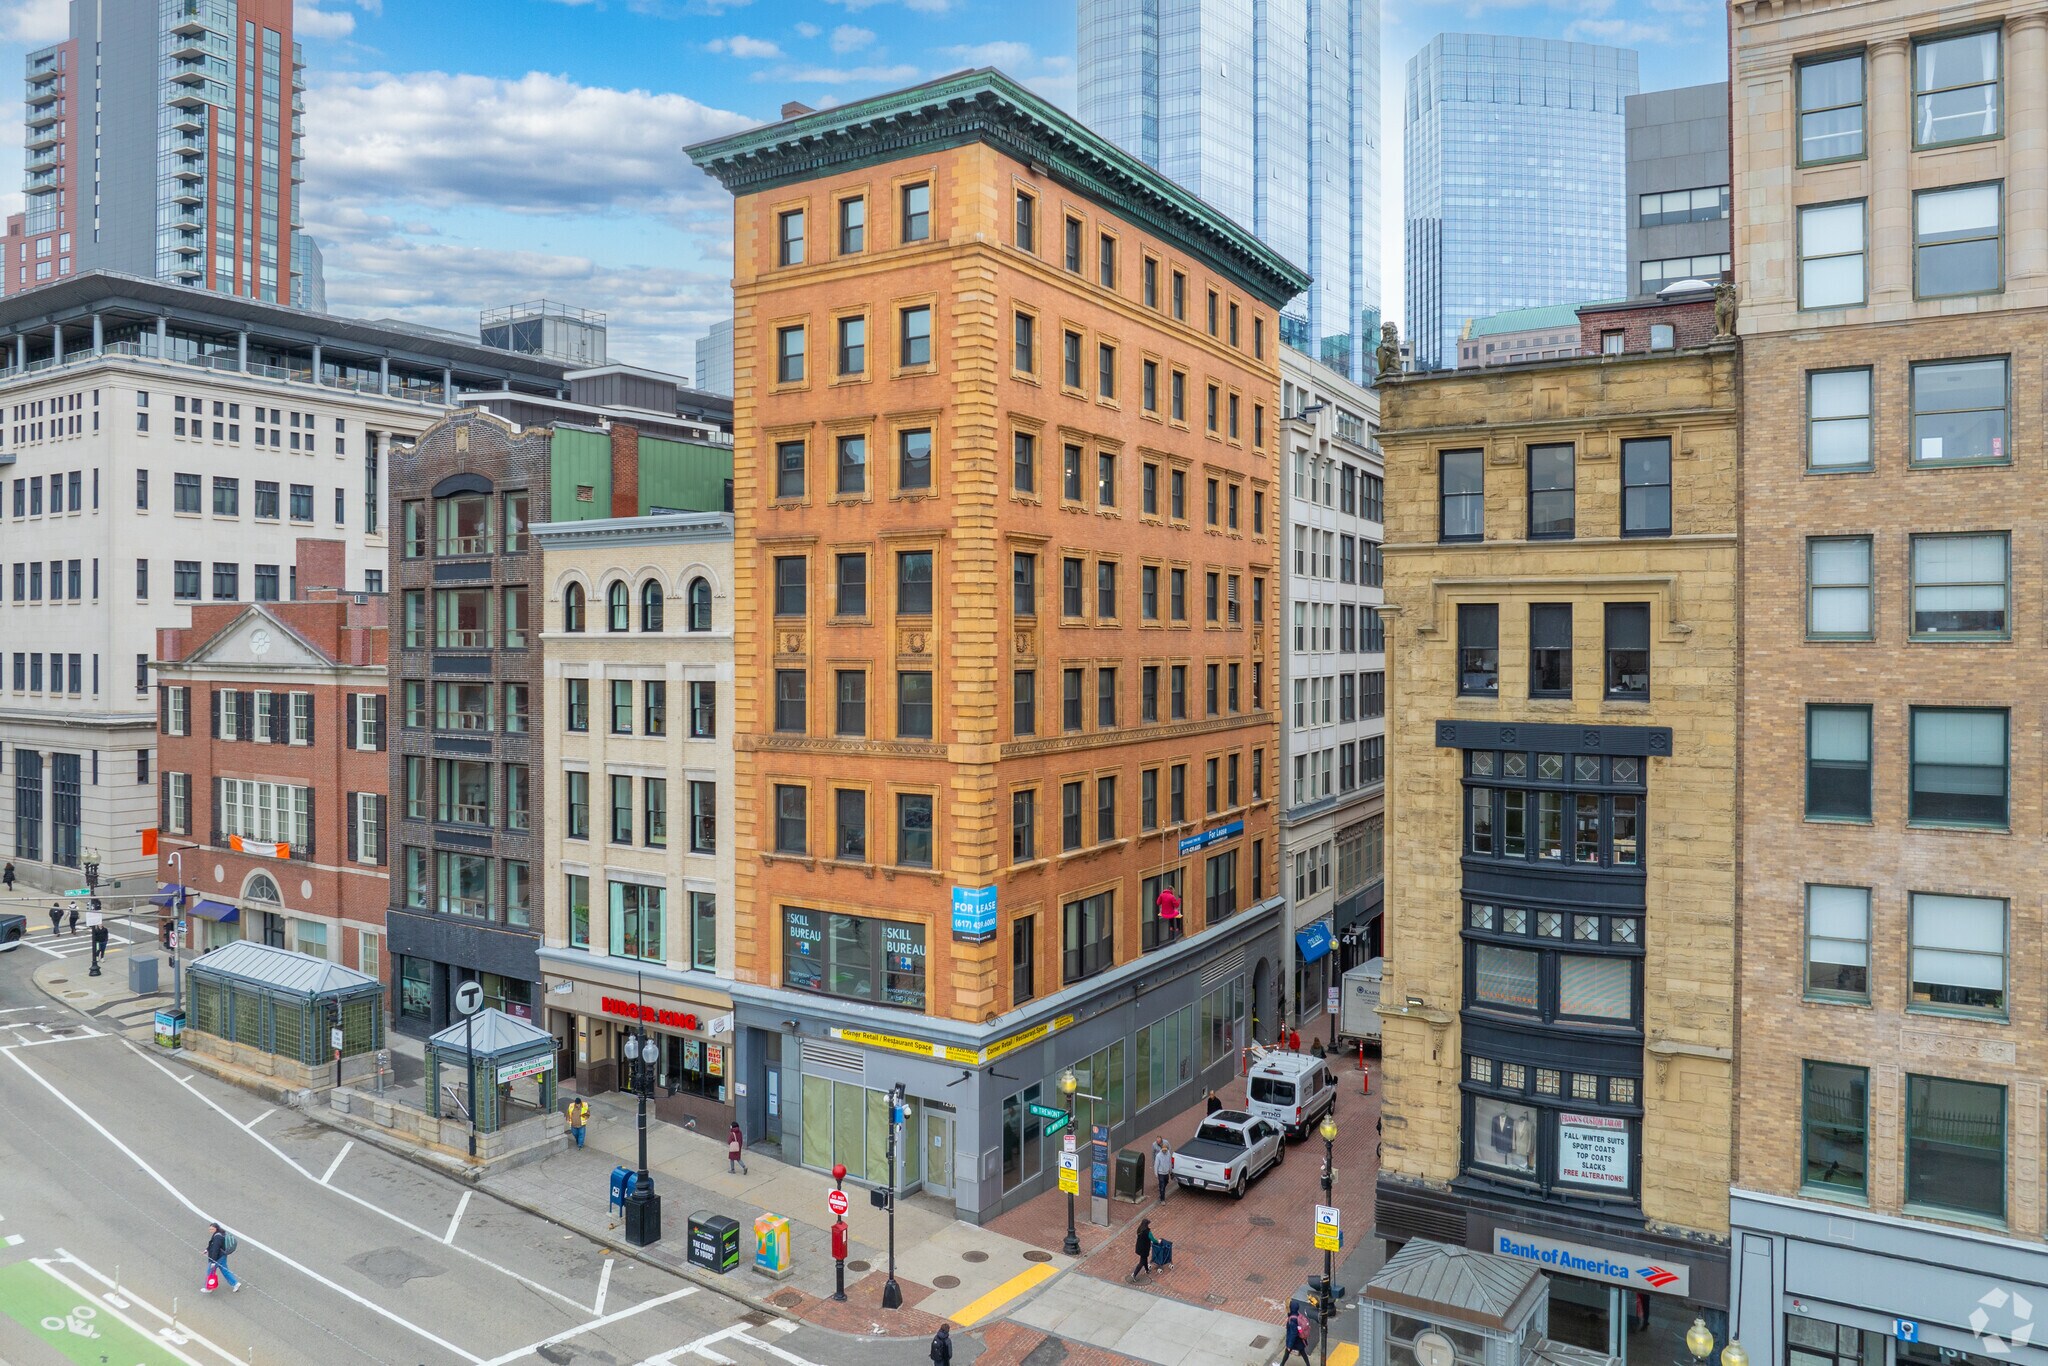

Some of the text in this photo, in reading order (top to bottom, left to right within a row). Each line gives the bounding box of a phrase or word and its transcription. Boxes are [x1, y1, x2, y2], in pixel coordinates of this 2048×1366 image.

[1208, 828, 1227, 839] For Lease
[954, 901, 996, 914] FOR LEASE
[790, 913, 809, 926] SKILL
[955, 919, 972, 930] (617)
[790, 926, 821, 942] BUREAU
[887, 927, 911, 940] SKILL
[1342, 934, 1357, 945] 41
[886, 941, 926, 956] BUREAU
[461, 987, 479, 1008] T
[602, 996, 656, 1022] BURGER
[658, 1009, 697, 1031] KING
[843, 1029, 861, 1038] Corner
[863, 1032, 879, 1041] Retail
[883, 1036, 914, 1048] Restaurant
[914, 1042, 933, 1052] Space
[987, 1045, 1001, 1055] Corner
[1001, 1040, 1013, 1049] Retail
[1015, 1029, 1036, 1043] Restaurant
[1036, 1024, 1048, 1034] Space
[1040, 1107, 1060, 1118] TREMONT
[1561, 1114, 1622, 1128] FRANK'S CUSTOM TAILOR
[1607, 1137, 1625, 1145] SUITS
[1572, 1142, 1615, 1154] SPORT COATS
[1591, 1153, 1612, 1162] COATS
[1582, 1162, 1606, 1171] SLACKS
[1581, 1171, 1624, 1182] ALTERATIONS!
[692, 1239, 700, 1249] THE
[701, 1242, 716, 1254] CROWN
[695, 1248, 714, 1261] IS YOURS
[1500, 1237, 1629, 1279] Bank of America
